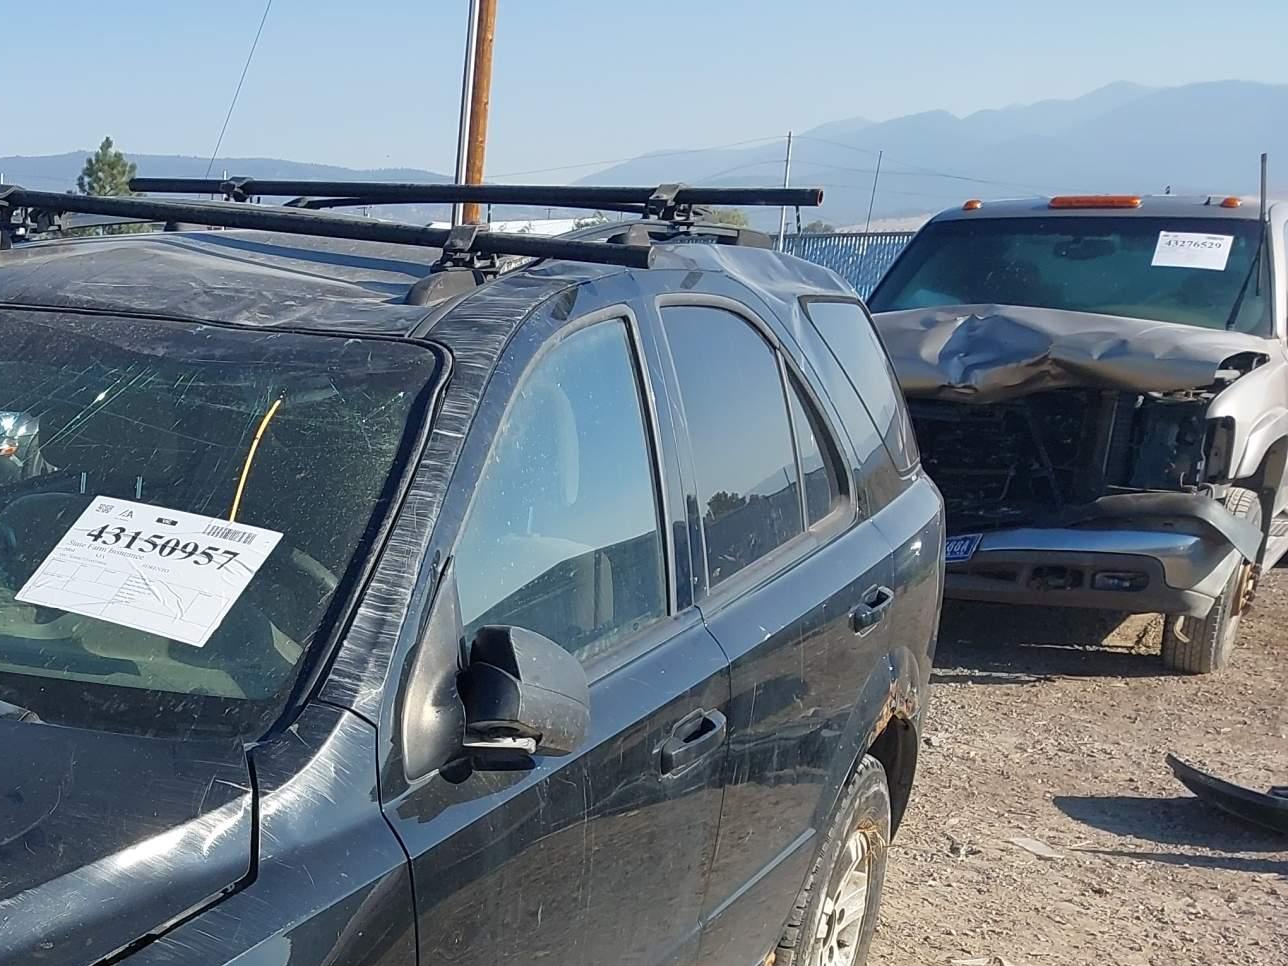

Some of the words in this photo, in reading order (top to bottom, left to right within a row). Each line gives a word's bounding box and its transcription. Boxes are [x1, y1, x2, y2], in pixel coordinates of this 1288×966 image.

[1165, 239, 1222, 249] 43276529
[86, 524, 240, 570] 43150957
[87, 542, 107, 553] Farm
[108, 547, 145, 560] Insurance
